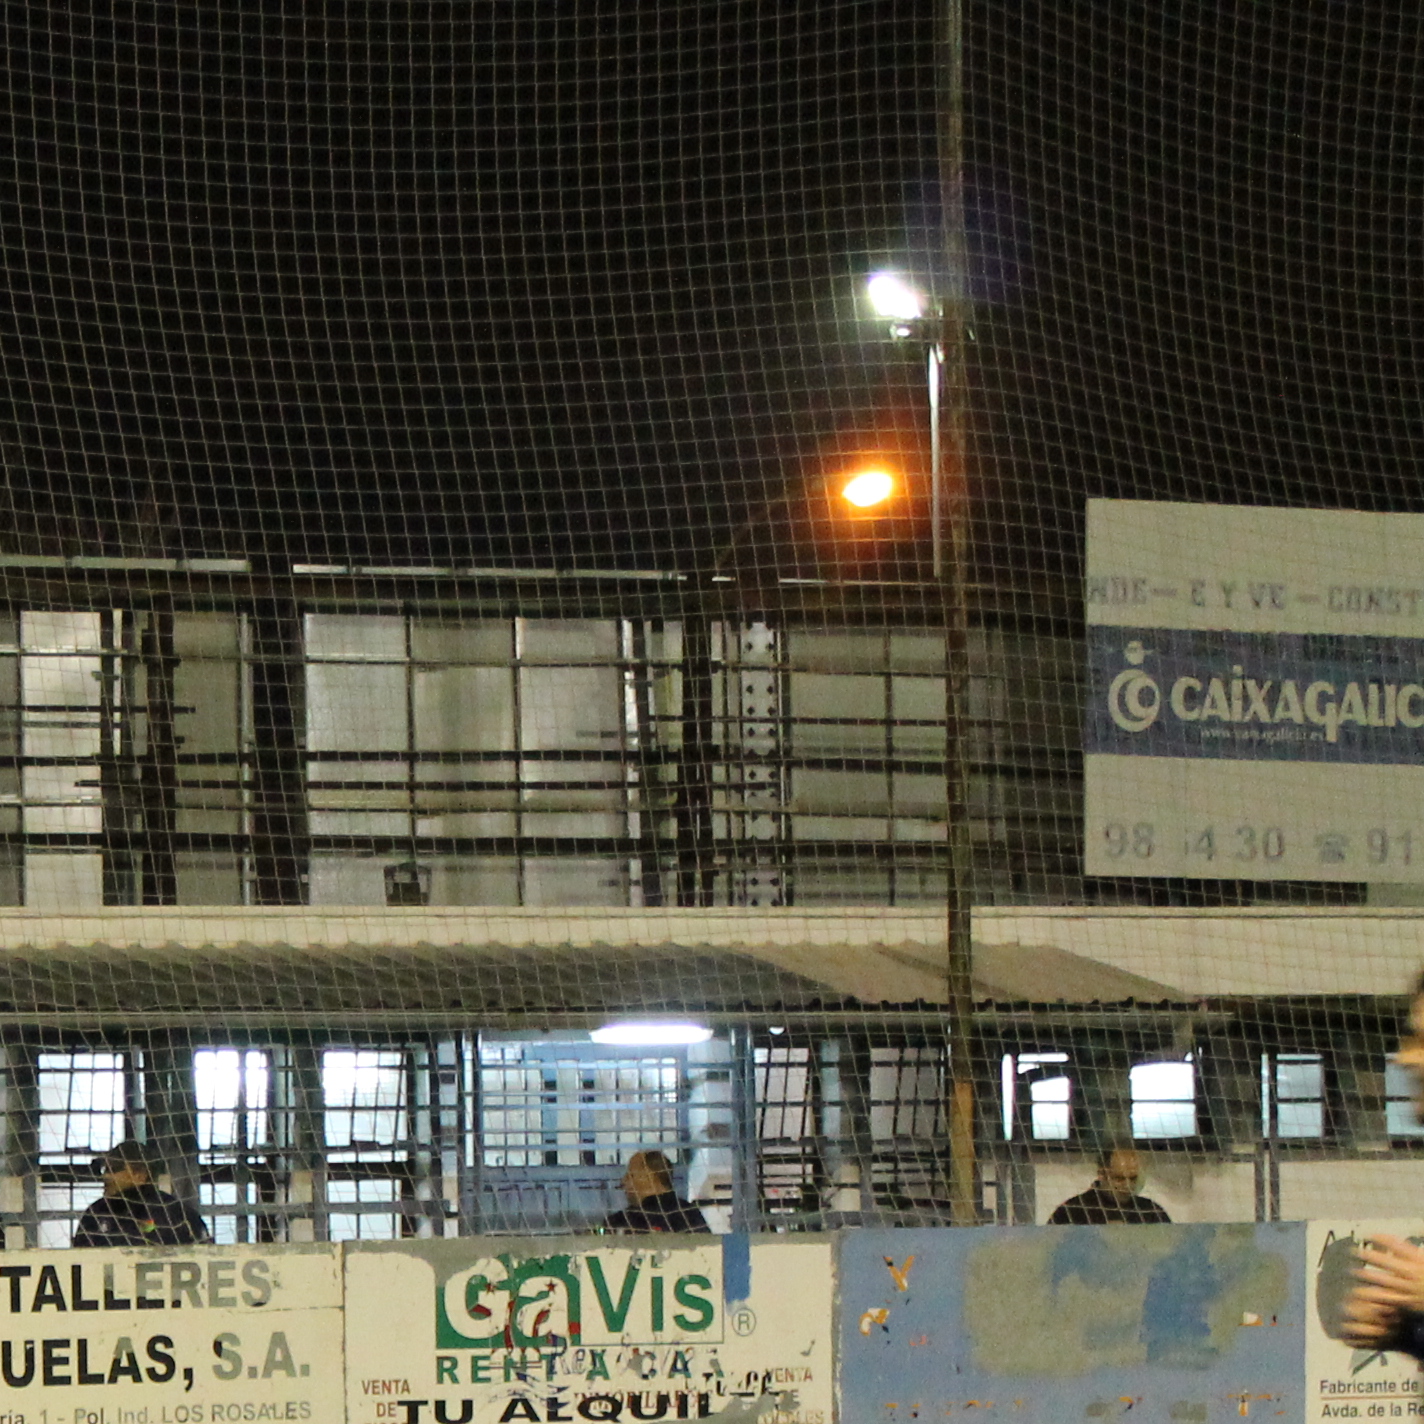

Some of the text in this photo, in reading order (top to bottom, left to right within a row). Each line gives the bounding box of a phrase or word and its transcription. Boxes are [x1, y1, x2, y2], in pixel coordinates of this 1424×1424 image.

[212, 1331, 312, 1380] S.A.
[361, 1379, 411, 1395] VENTA
[1319, 1378, 1419, 1394] Fabricante de
[117, 1406, 154, 1424] Ind.
[162, 1404, 204, 1424] LOS
[211, 1401, 312, 1423] ROSALES
[376, 1402, 397, 1418] DE
[1321, 1402, 1363, 1418] Avda.
[1367, 1402, 1385, 1417] de
[1390, 1402, 1403, 1417] la
